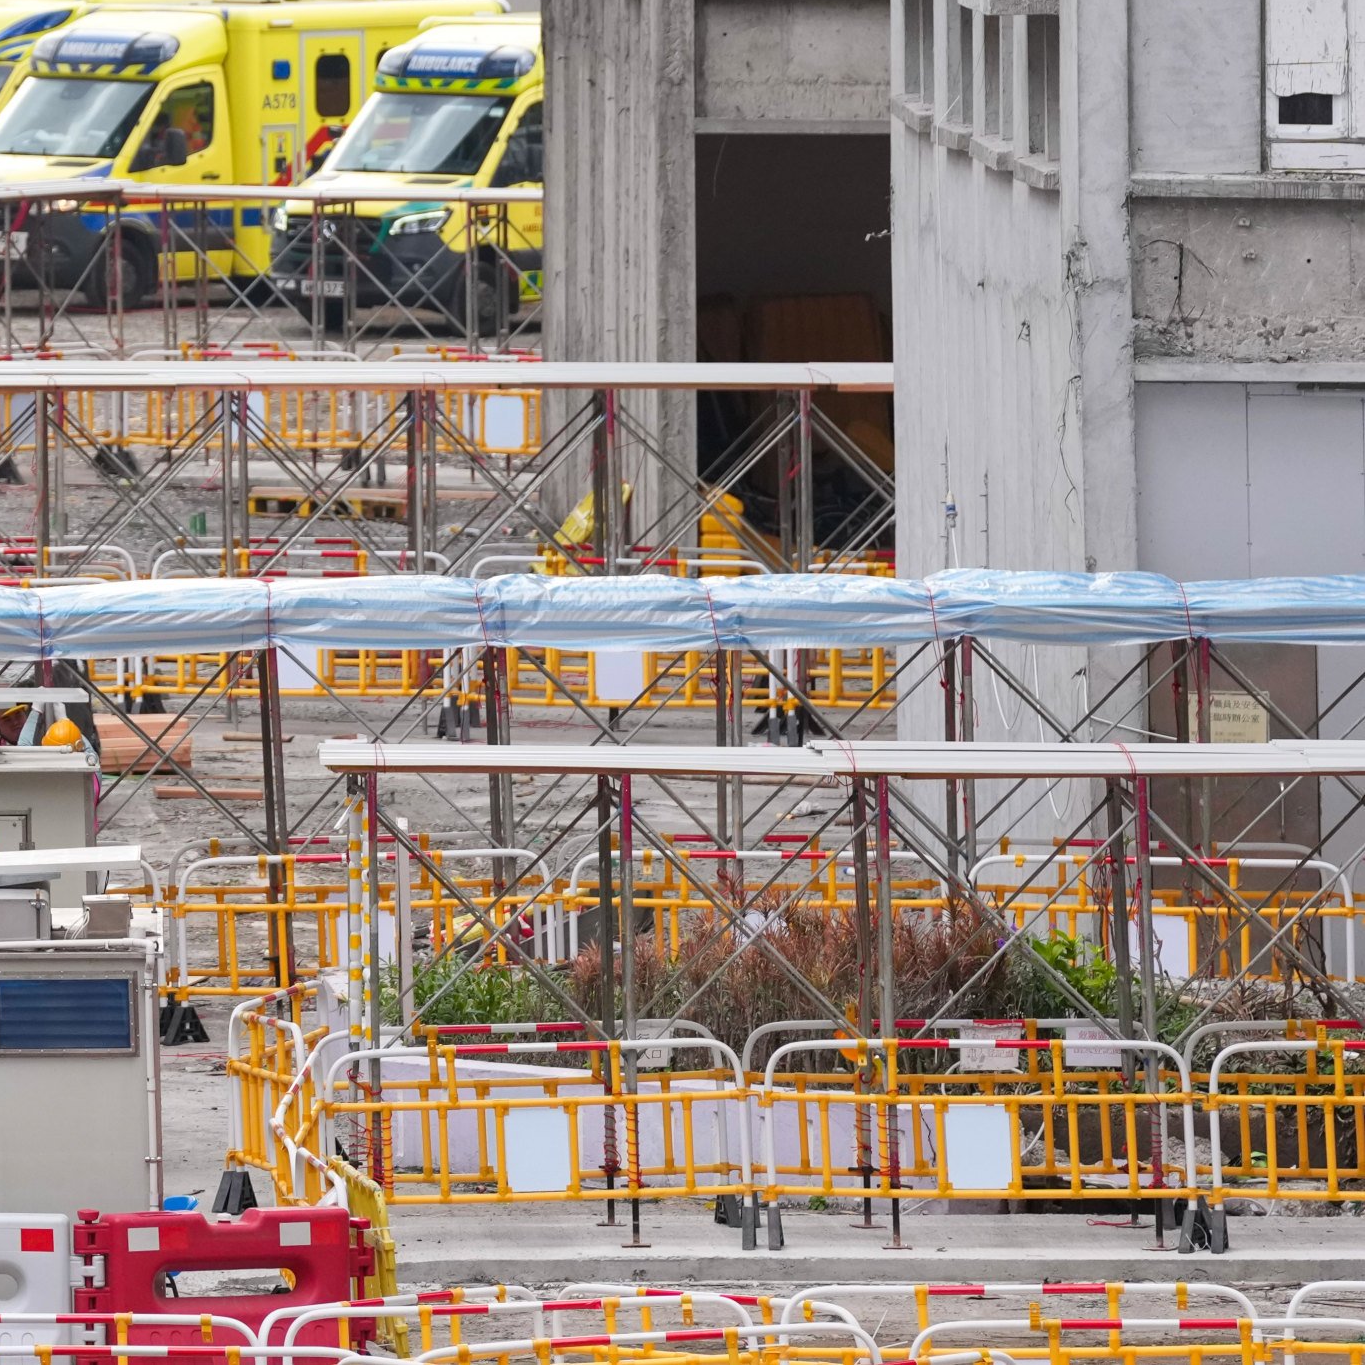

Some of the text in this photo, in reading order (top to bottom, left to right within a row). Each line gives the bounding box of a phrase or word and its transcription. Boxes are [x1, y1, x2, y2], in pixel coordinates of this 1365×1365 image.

[58, 41, 127, 59] AMBULANCE
[407, 55, 483, 73] AMBULANCE
[262, 93, 296, 109] A578
